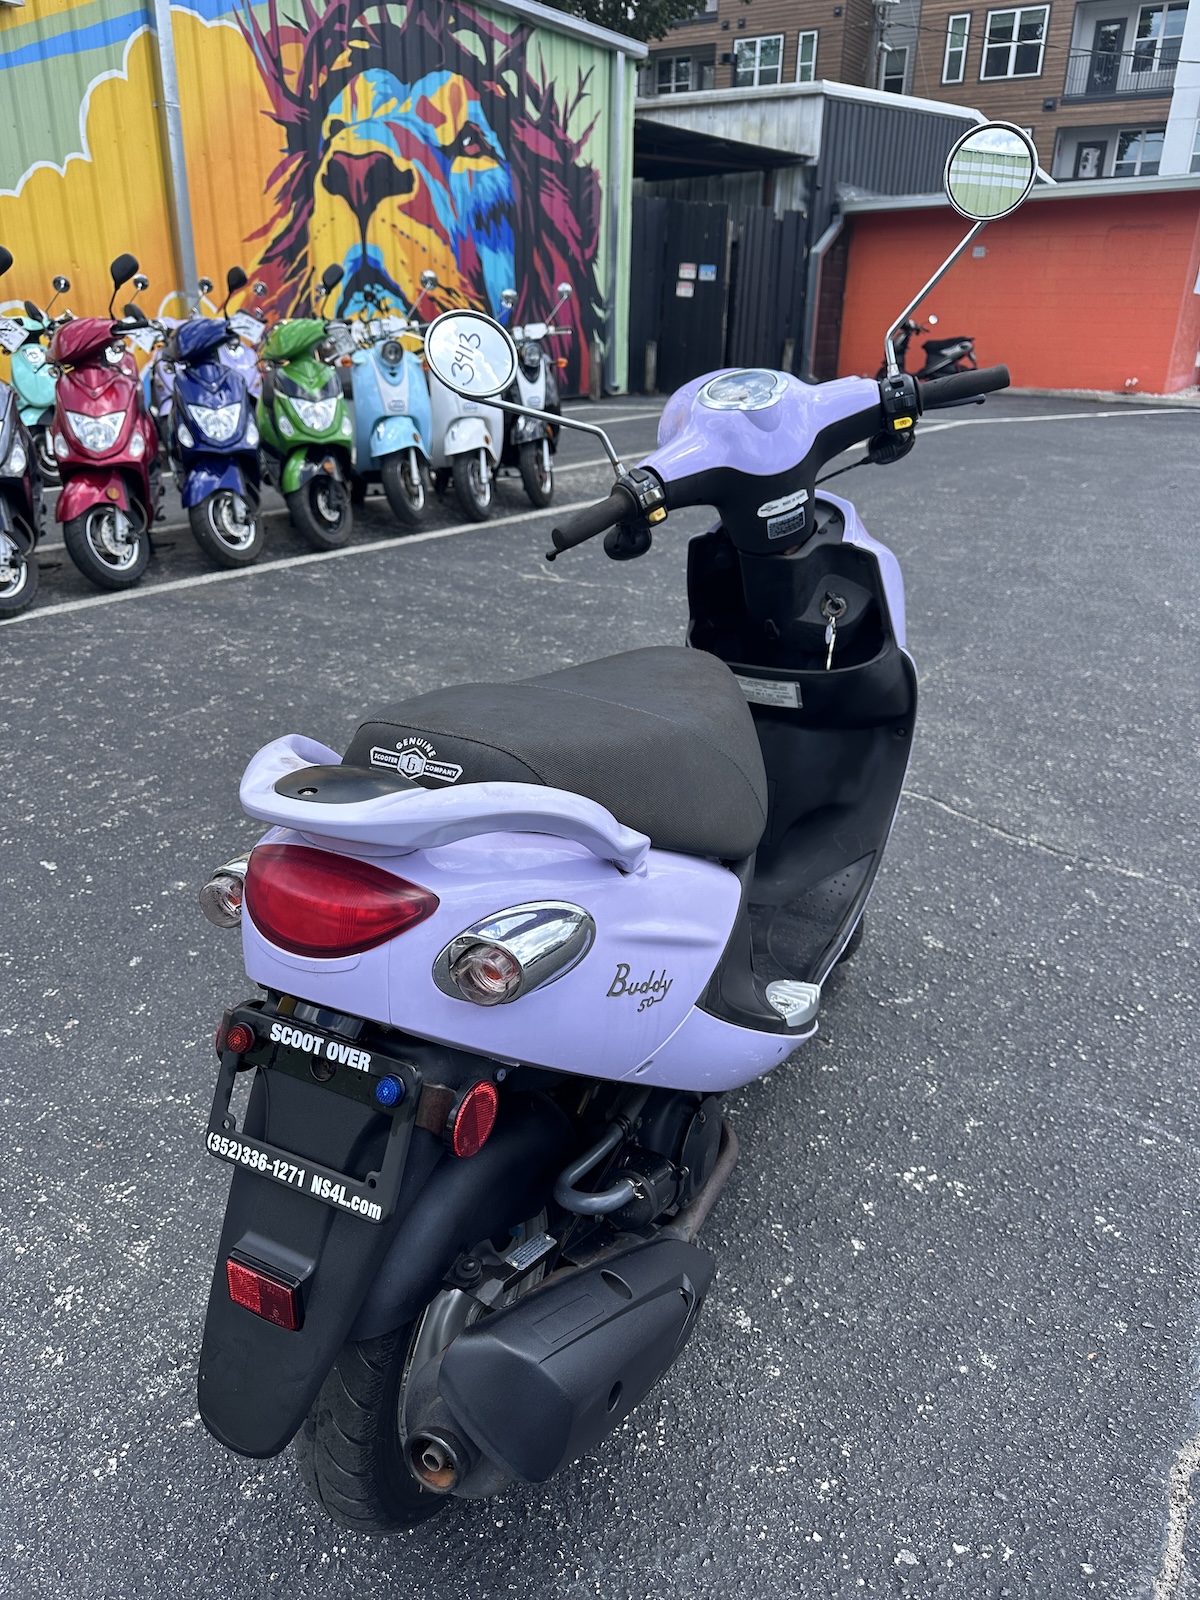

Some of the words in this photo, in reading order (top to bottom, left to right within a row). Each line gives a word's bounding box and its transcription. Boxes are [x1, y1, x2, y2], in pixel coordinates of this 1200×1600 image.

[450, 333, 481, 386] 3413
[374, 752, 398, 764] SCOOTER
[395, 737, 437, 758] GENUINE
[425, 765, 457, 776] COMPANY
[606, 963, 674, 1002] Buddy
[637, 996, 655, 1012] 50
[269, 1022, 325, 1056] SCOOT
[326, 1042, 372, 1072] OVER
[206, 1131, 306, 1188] (352)336-1271
[310, 1175, 382, 1221] NS4L.com
